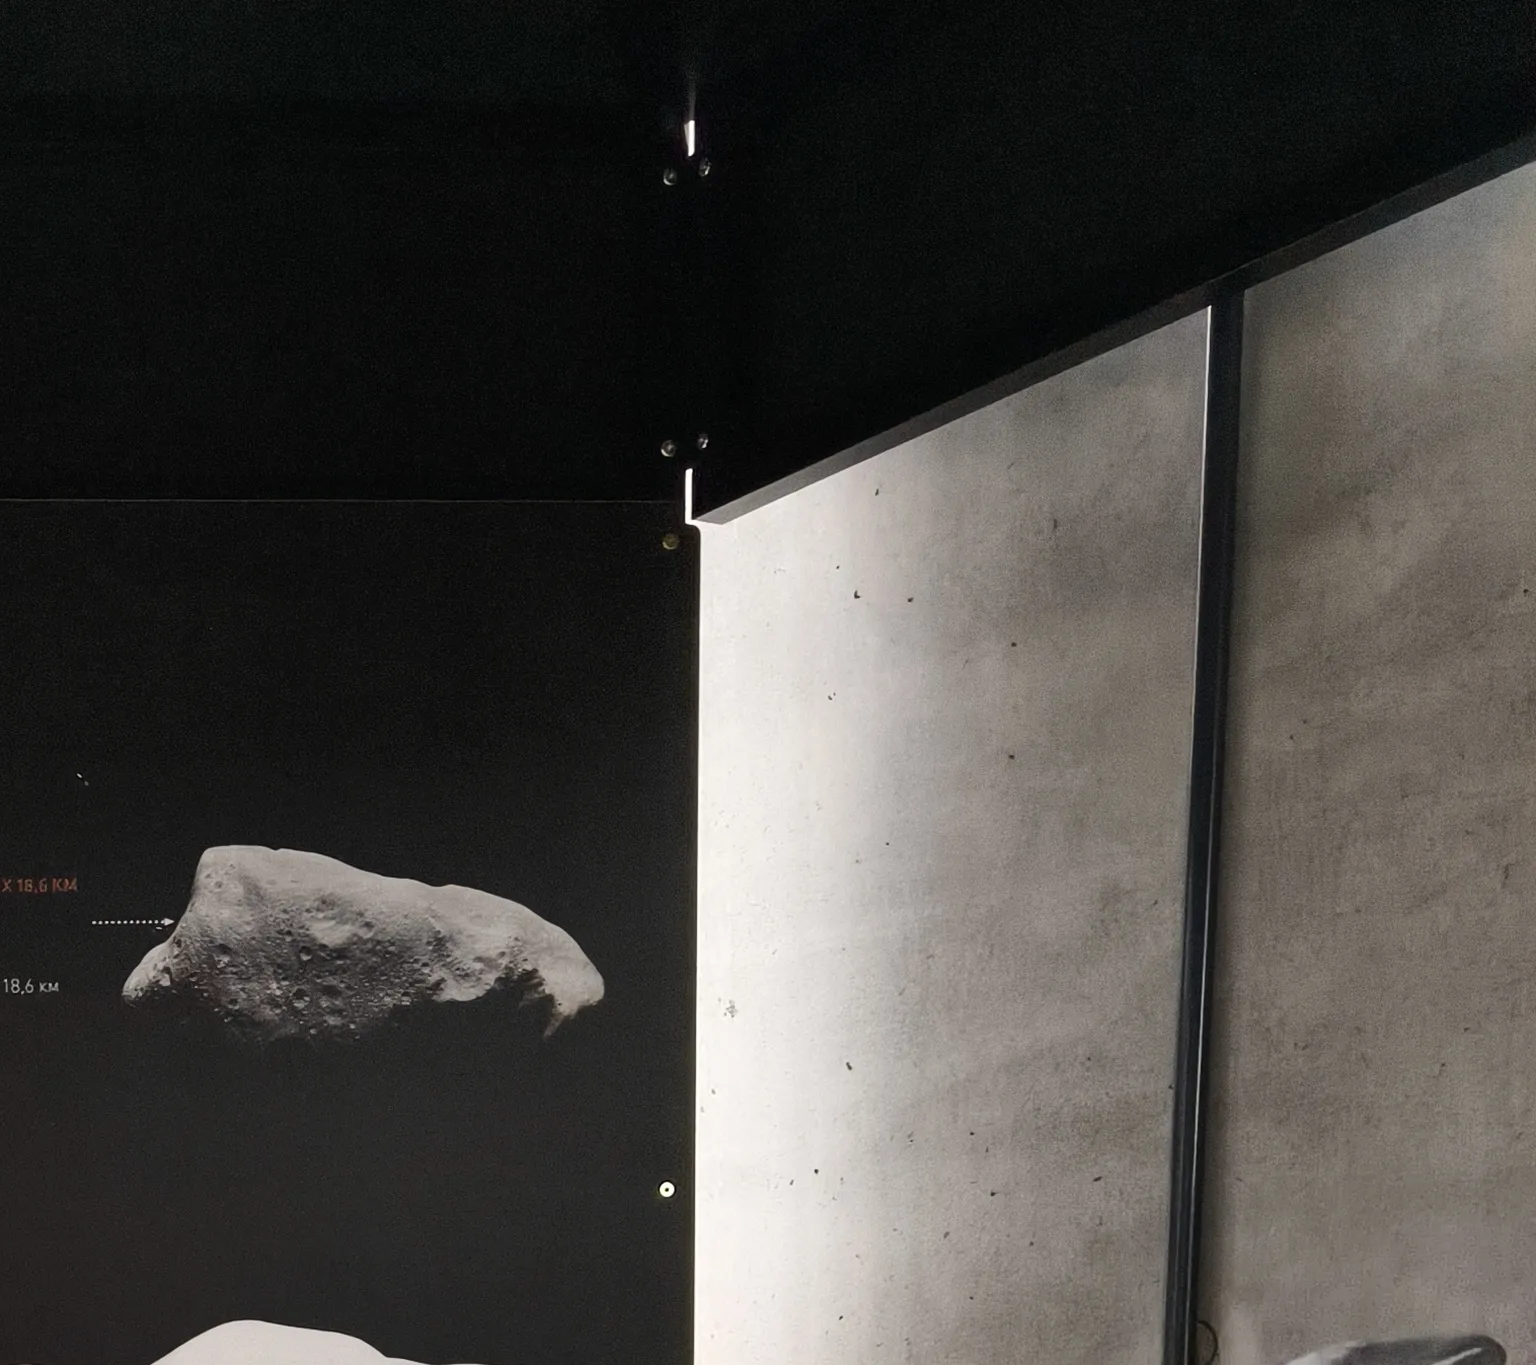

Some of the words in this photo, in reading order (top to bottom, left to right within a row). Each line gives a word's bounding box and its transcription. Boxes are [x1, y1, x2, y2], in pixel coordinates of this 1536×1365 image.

[2, 878, 12, 892] X
[52, 878, 78, 892] KM
[2, 979, 35, 995] 18,6
[39, 980, 60, 993] км
